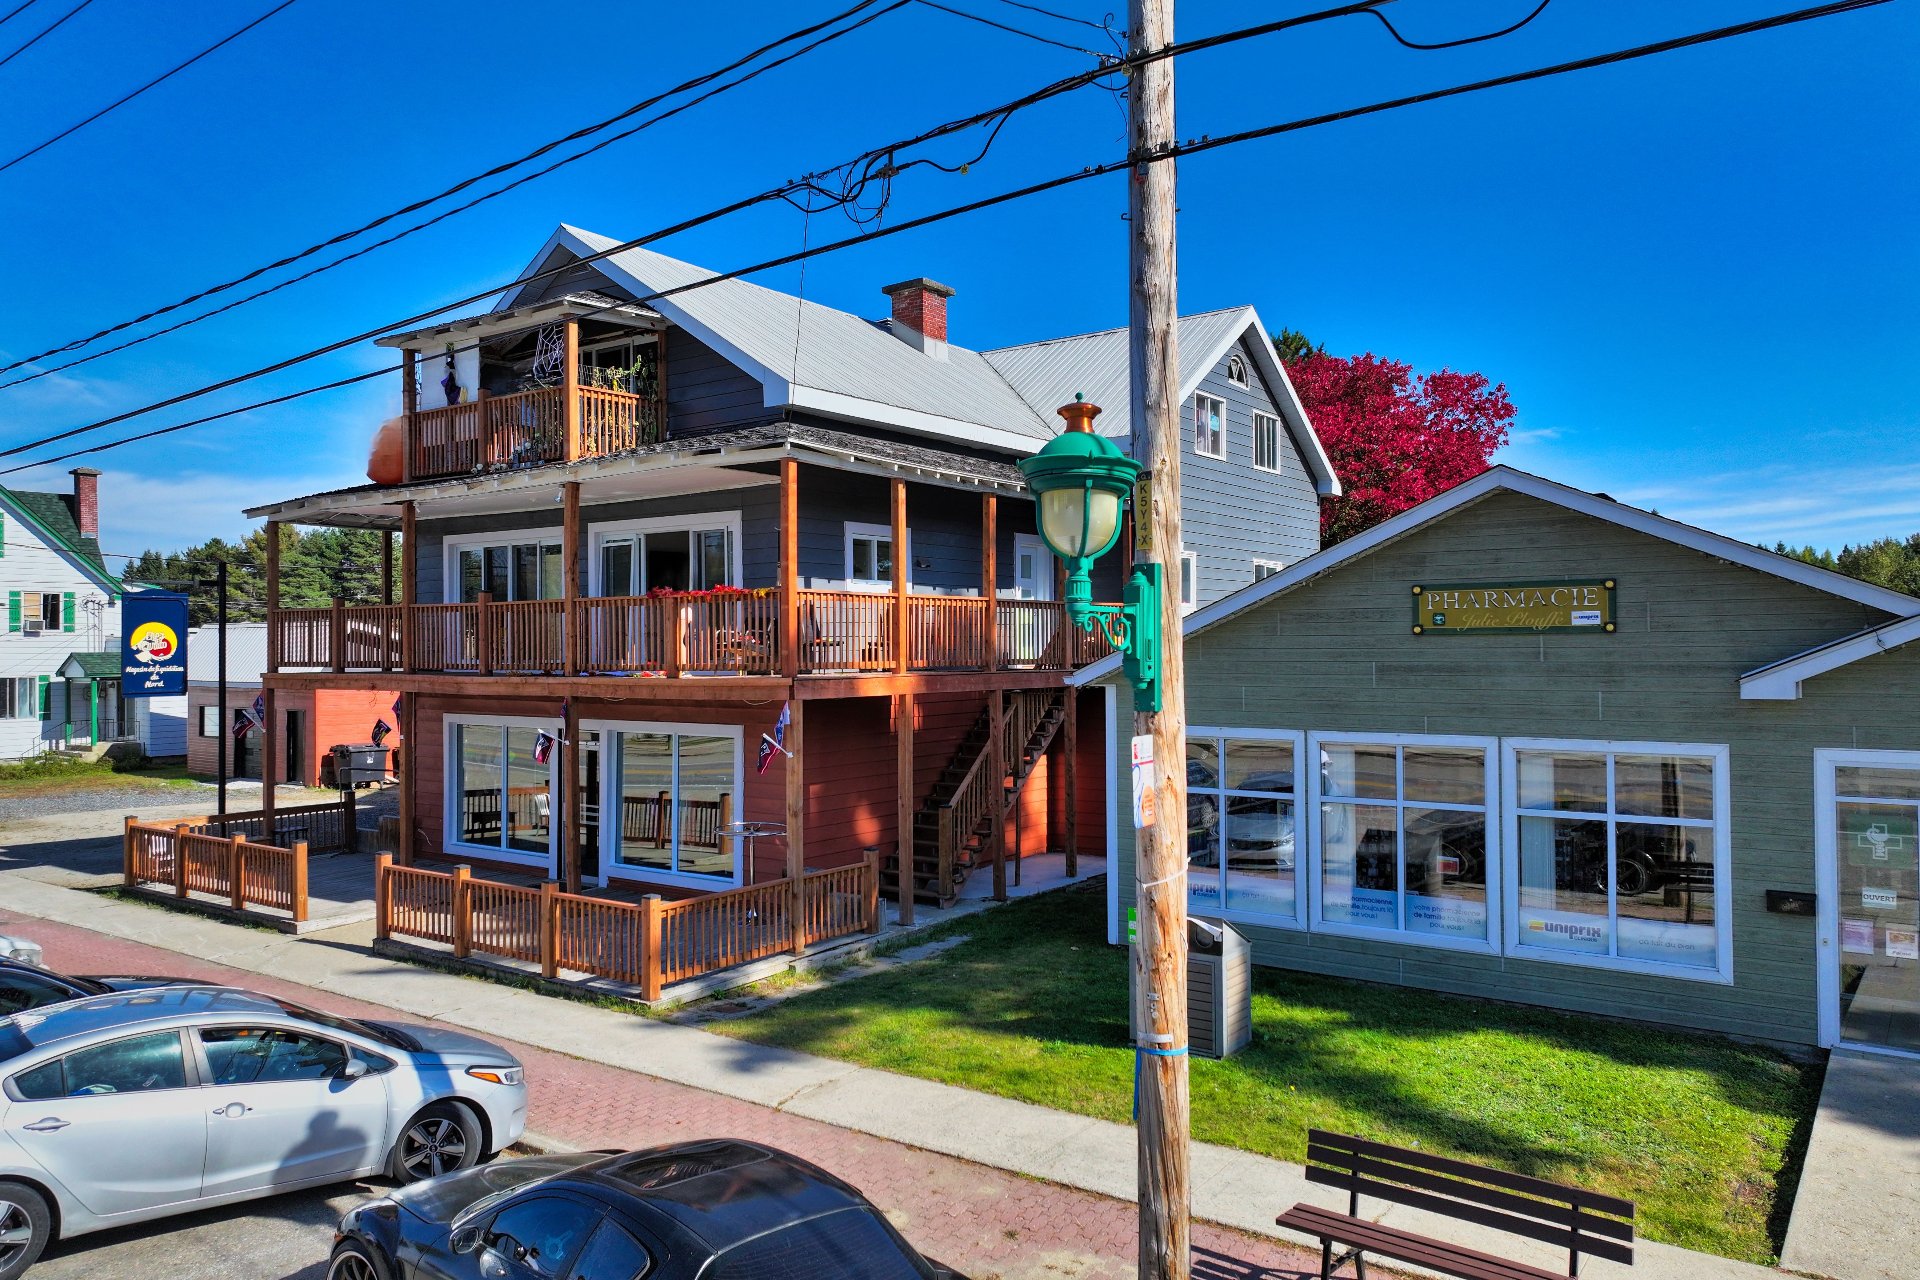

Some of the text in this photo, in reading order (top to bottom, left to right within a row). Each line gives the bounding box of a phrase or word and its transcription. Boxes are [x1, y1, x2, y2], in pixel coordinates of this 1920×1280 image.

[1140, 484, 1148, 545] K5Y4X
[1426, 588, 1599, 609] PHARMACIE
[1457, 612, 1500, 631] Julie
[1863, 893, 1895, 902] OUVERT
[1544, 922, 1601, 939] uniprix
